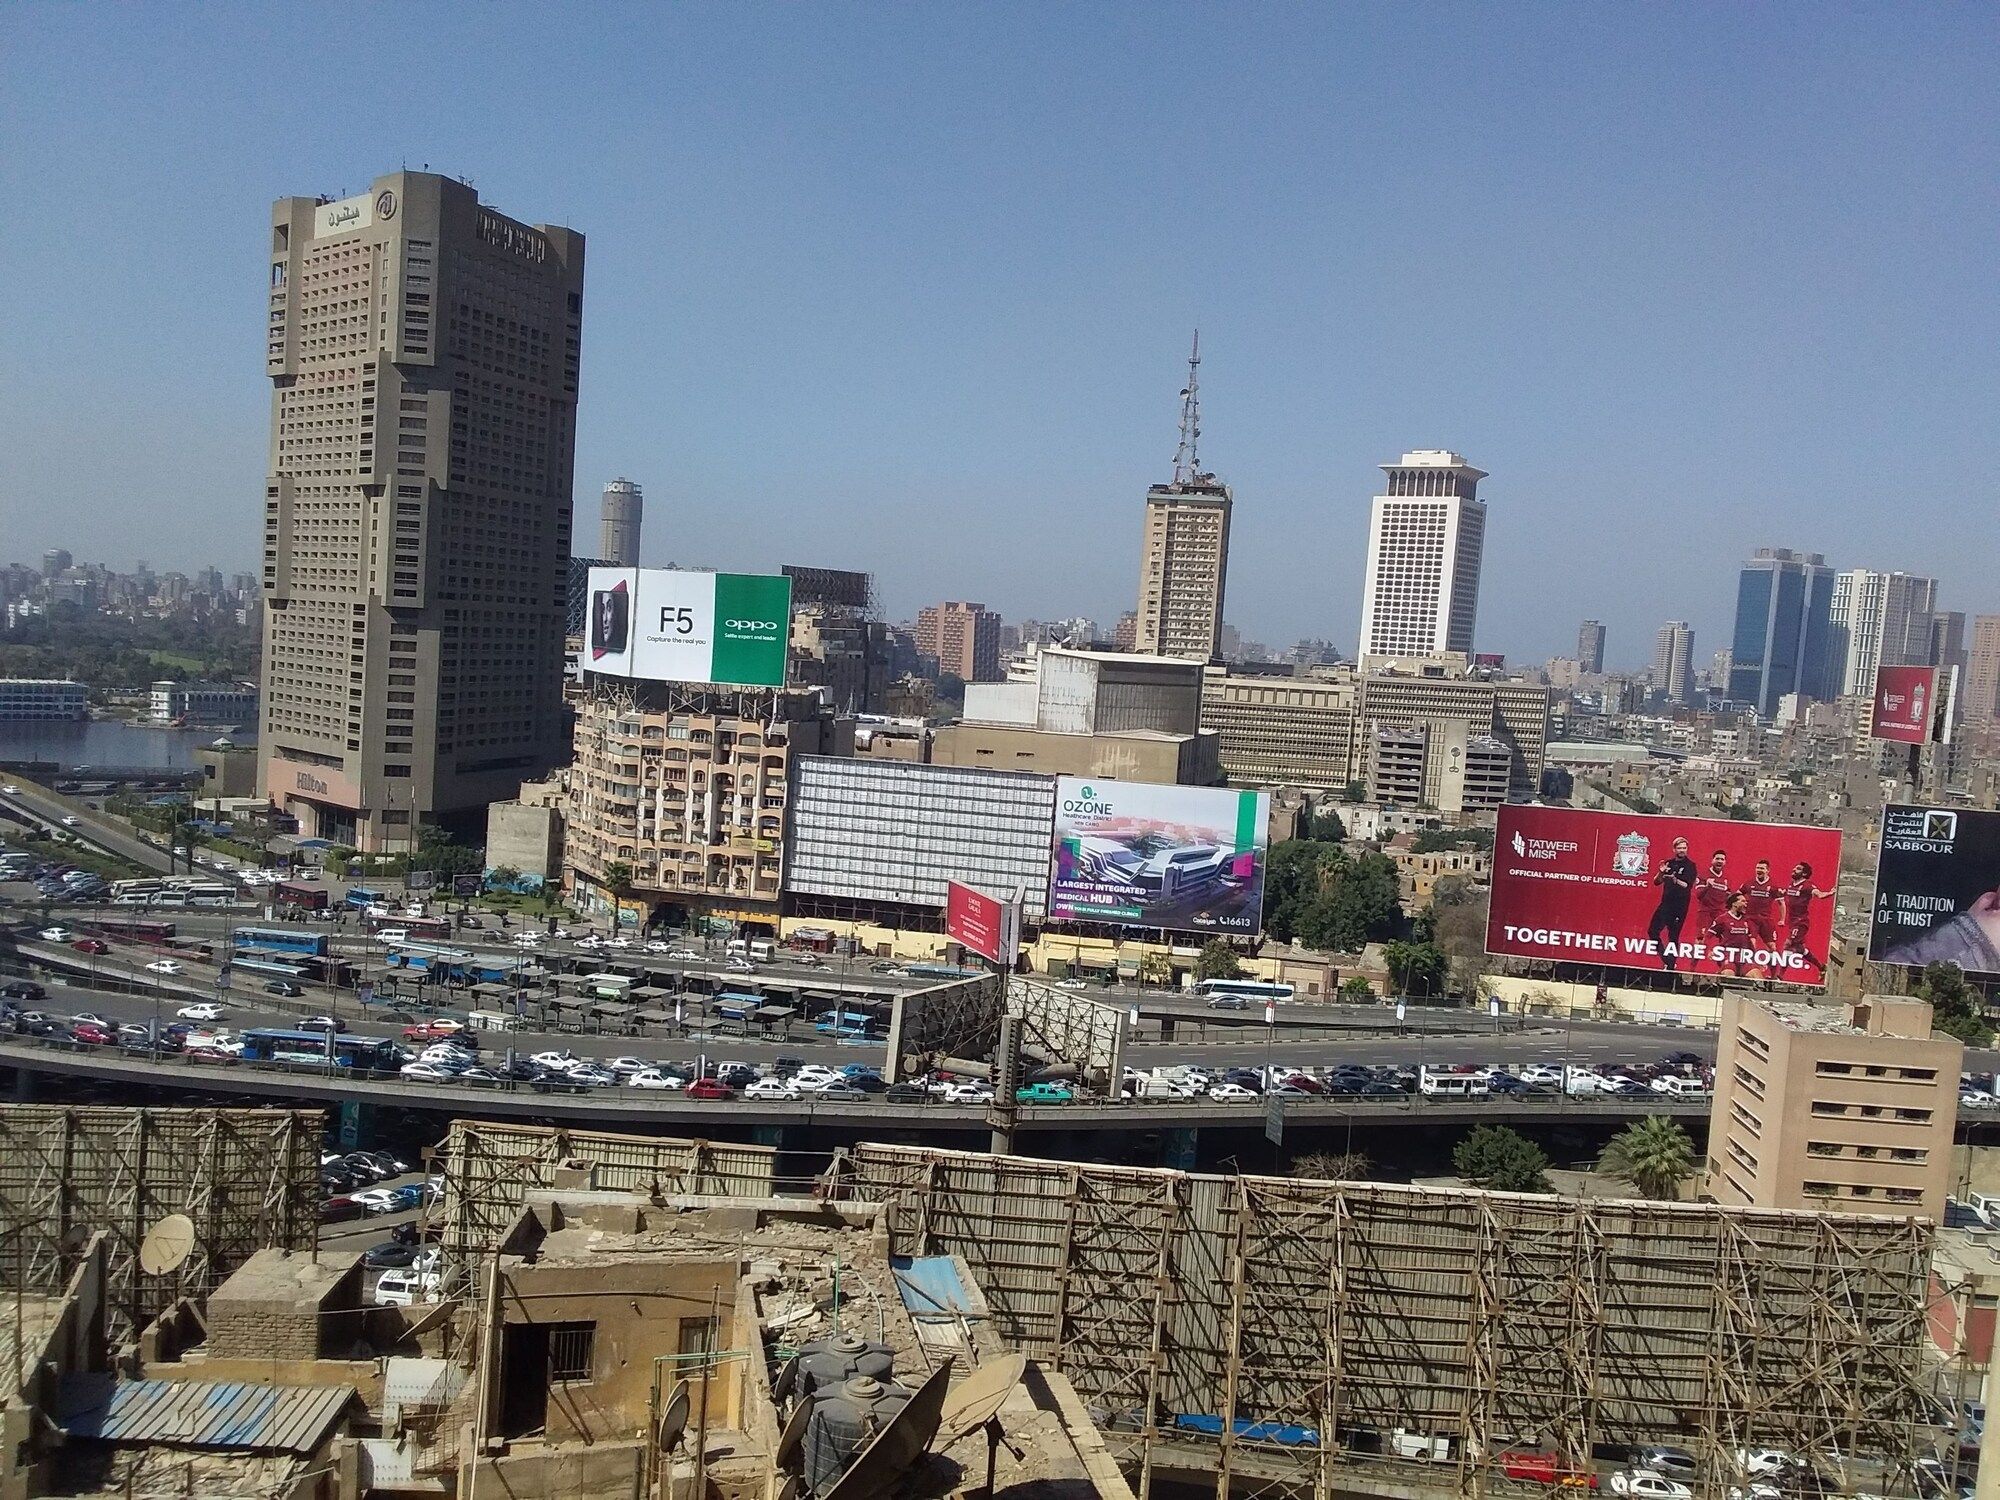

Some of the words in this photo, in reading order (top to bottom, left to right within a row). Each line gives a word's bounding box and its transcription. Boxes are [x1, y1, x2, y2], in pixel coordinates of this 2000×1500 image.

[660, 606, 693, 634] F5
[296, 771, 328, 795] Hilton
[1063, 800, 1114, 815] OZONE
[1527, 838, 1578, 852] TATWEER
[1884, 840, 1954, 854] SABBOUR
[1528, 850, 1557, 860] MISR
[1509, 868, 1542, 878] OFFICIAL
[1544, 872, 1580, 882] PARTNER
[1592, 876, 1636, 887] LIVERPOOL
[1057, 880, 1095, 890] LARGEST
[1096, 884, 1147, 895] INTEGRATED
[1056, 892, 1090, 902] MEDICAL
[1090, 894, 1113, 904] HUB
[1879, 892, 1888, 906] A
[1896, 894, 1955, 912] TRADITION
[1226, 916, 1250, 927] 16613
[1878, 910, 1894, 924] OF
[1896, 911, 1934, 928] TRUST
[1504, 925, 1618, 952] TOGETHER
[1623, 937, 1658, 956] WE
[1663, 941, 1706, 960] ARE
[1712, 945, 1810, 970] STRONG.
